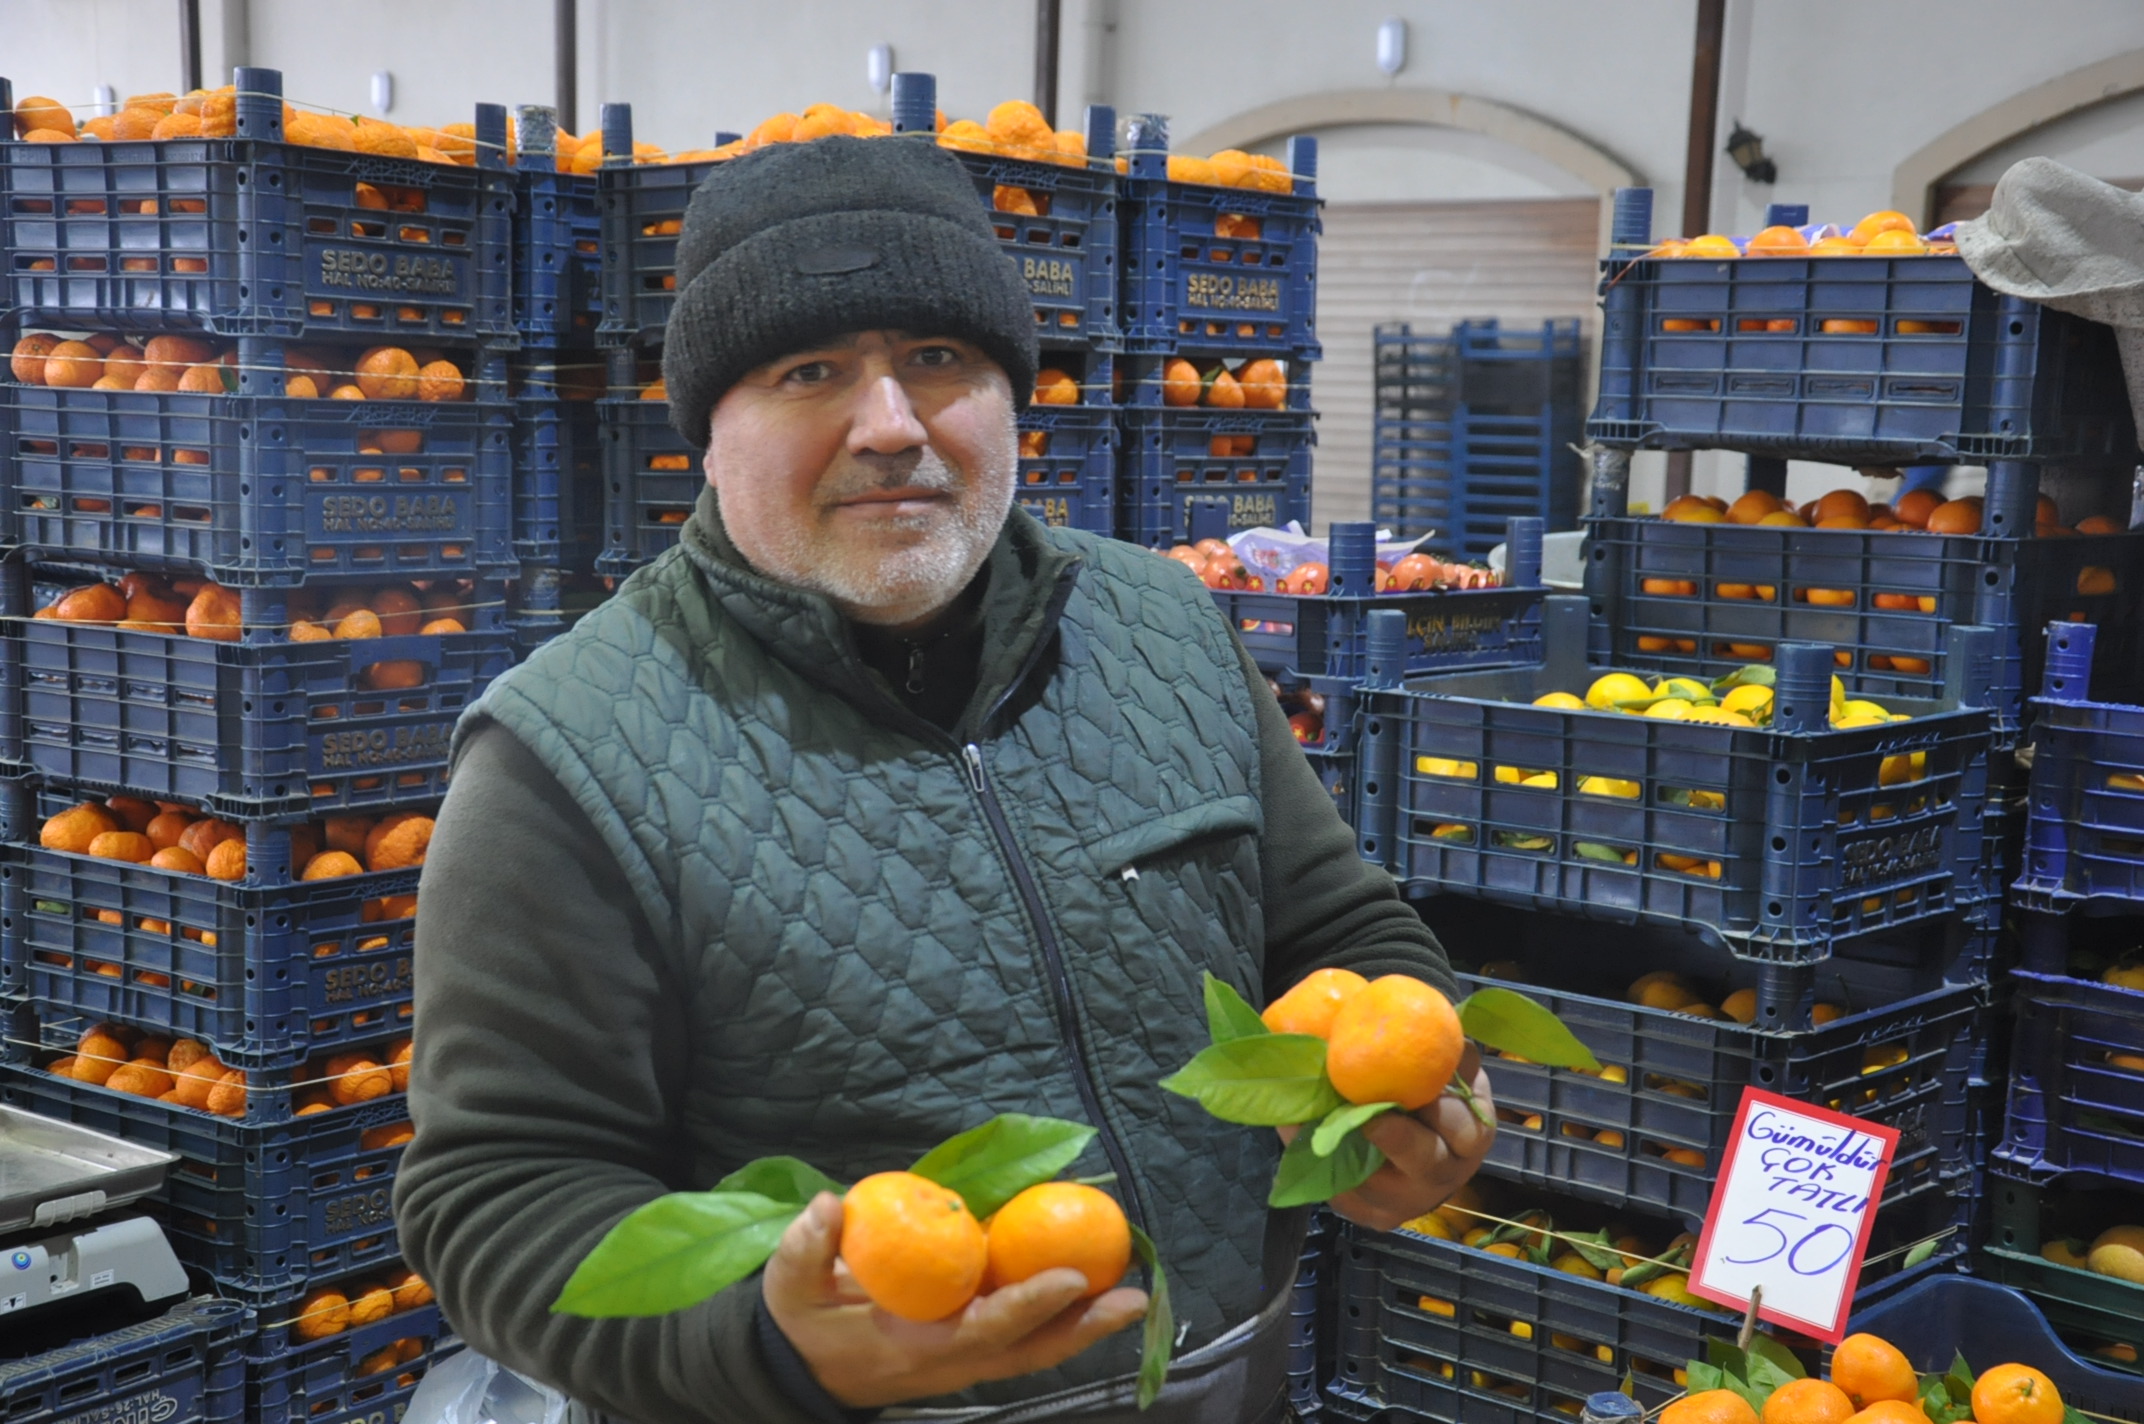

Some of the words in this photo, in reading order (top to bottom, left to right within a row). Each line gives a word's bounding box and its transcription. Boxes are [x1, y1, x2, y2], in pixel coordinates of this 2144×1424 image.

[322, 249, 387, 275] SEDO
[395, 255, 455, 279] BABA
[322, 271, 352, 287] HAL
[1024, 257, 1074, 281] BABA
[1188, 273, 1233, 296] SEDO
[1238, 277, 1278, 299] BABA
[323, 496, 387, 518] SEDO
[395, 495, 456, 518] BABA
[1233, 494, 1275, 514] BABA
[323, 728, 387, 755] SEDO
[395, 722, 454, 748] BABA
[325, 961, 388, 992] SEDO
[1761, 1147, 1837, 1181] ÇOK
[325, 1188, 388, 1223] SEDO
[1768, 1176, 1869, 1214] TATLI
[1725, 1208, 1854, 1276] 50
